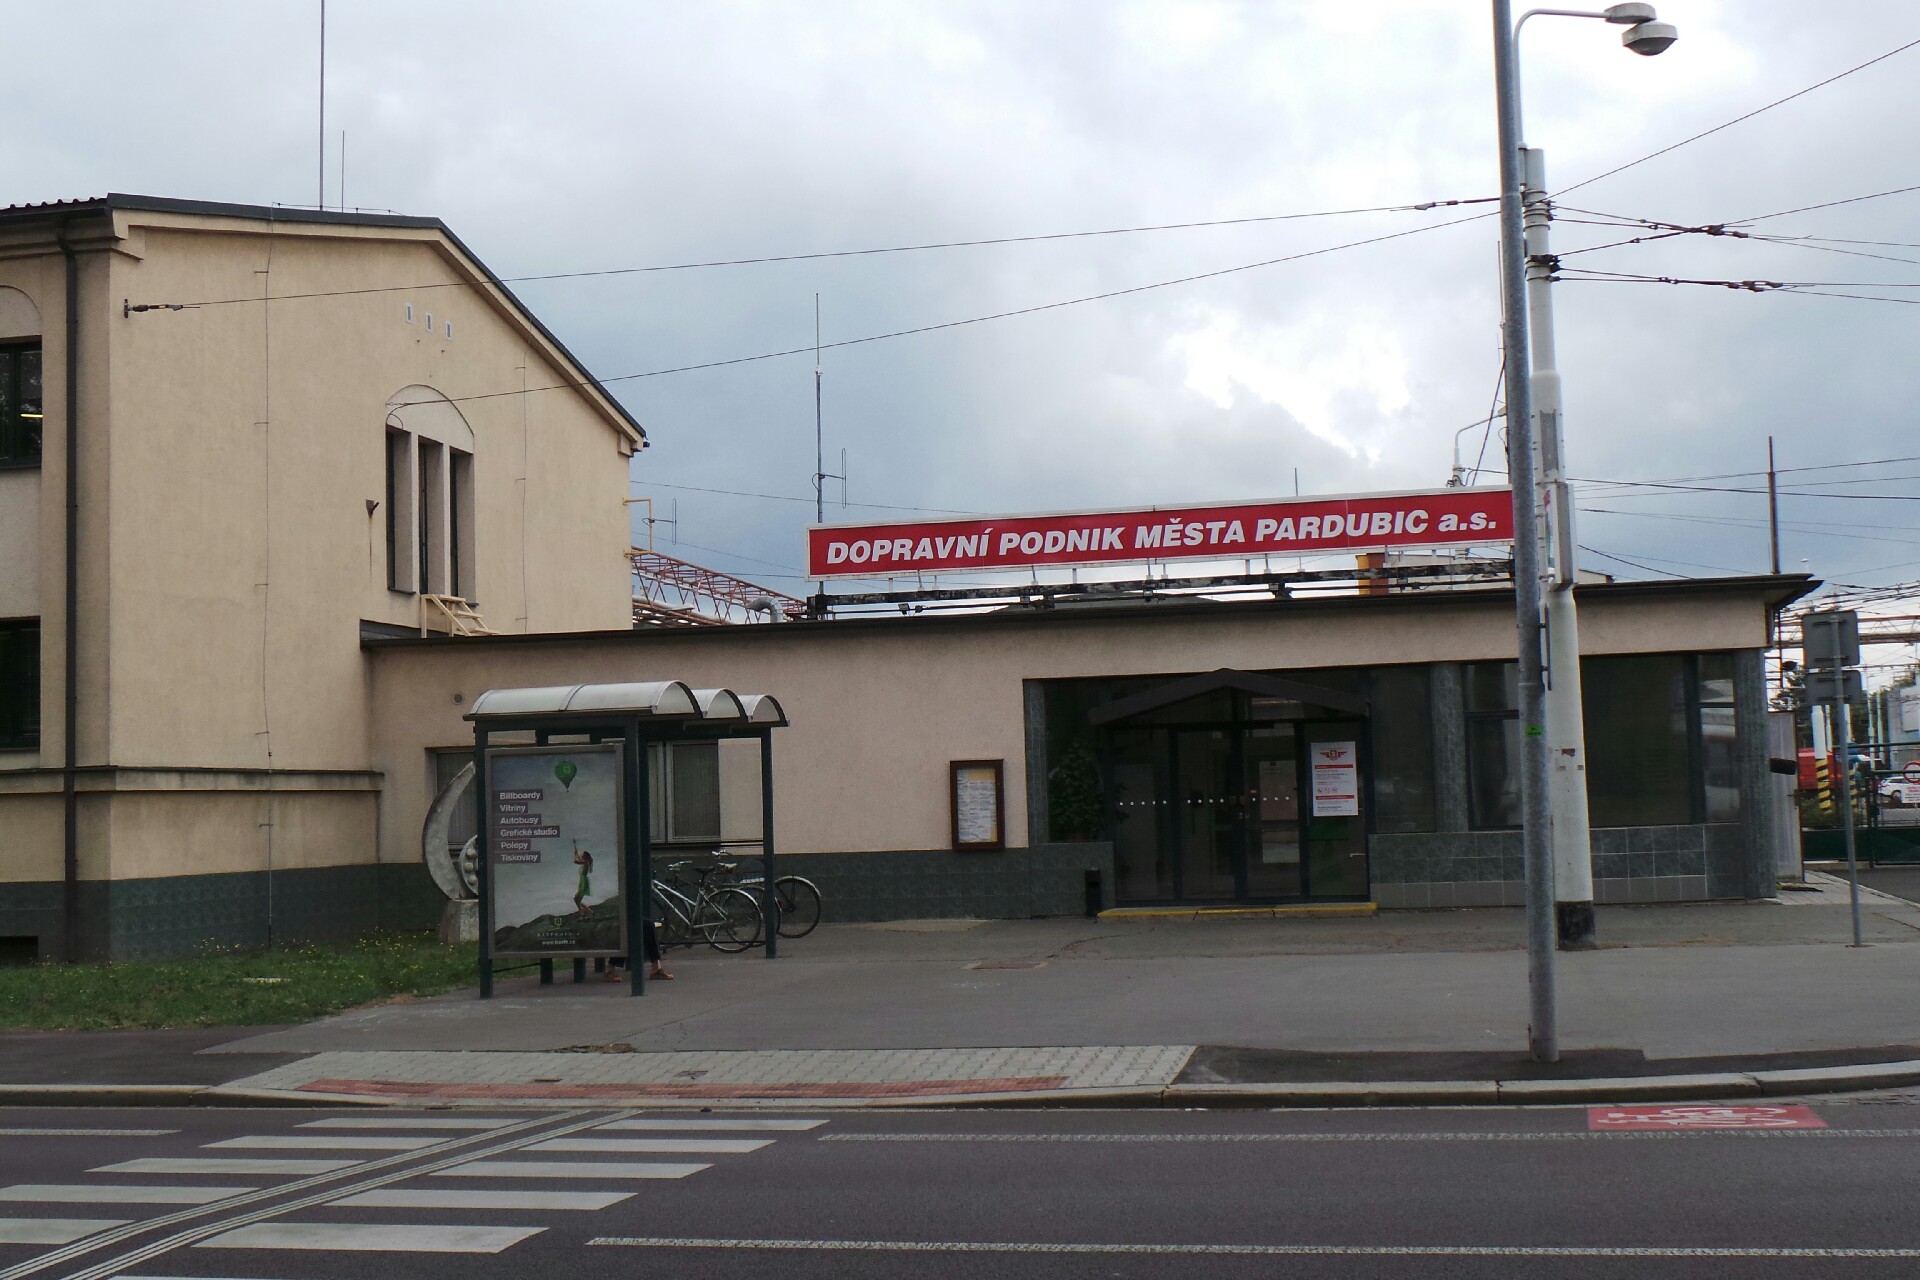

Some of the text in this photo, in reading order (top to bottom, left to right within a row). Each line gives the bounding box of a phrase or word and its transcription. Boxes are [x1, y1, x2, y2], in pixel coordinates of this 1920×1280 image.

[826, 509, 1497, 564] DOPRAVNÍ PODNIK MĚSTA PARDUBIC a.s.
[499, 791, 541, 800] Billboardy
[500, 816, 539, 825] Autobusy
[500, 827, 558, 837] Grafické studio
[500, 842, 529, 850] Polepy
[500, 854, 539, 862] Tiskoviny
